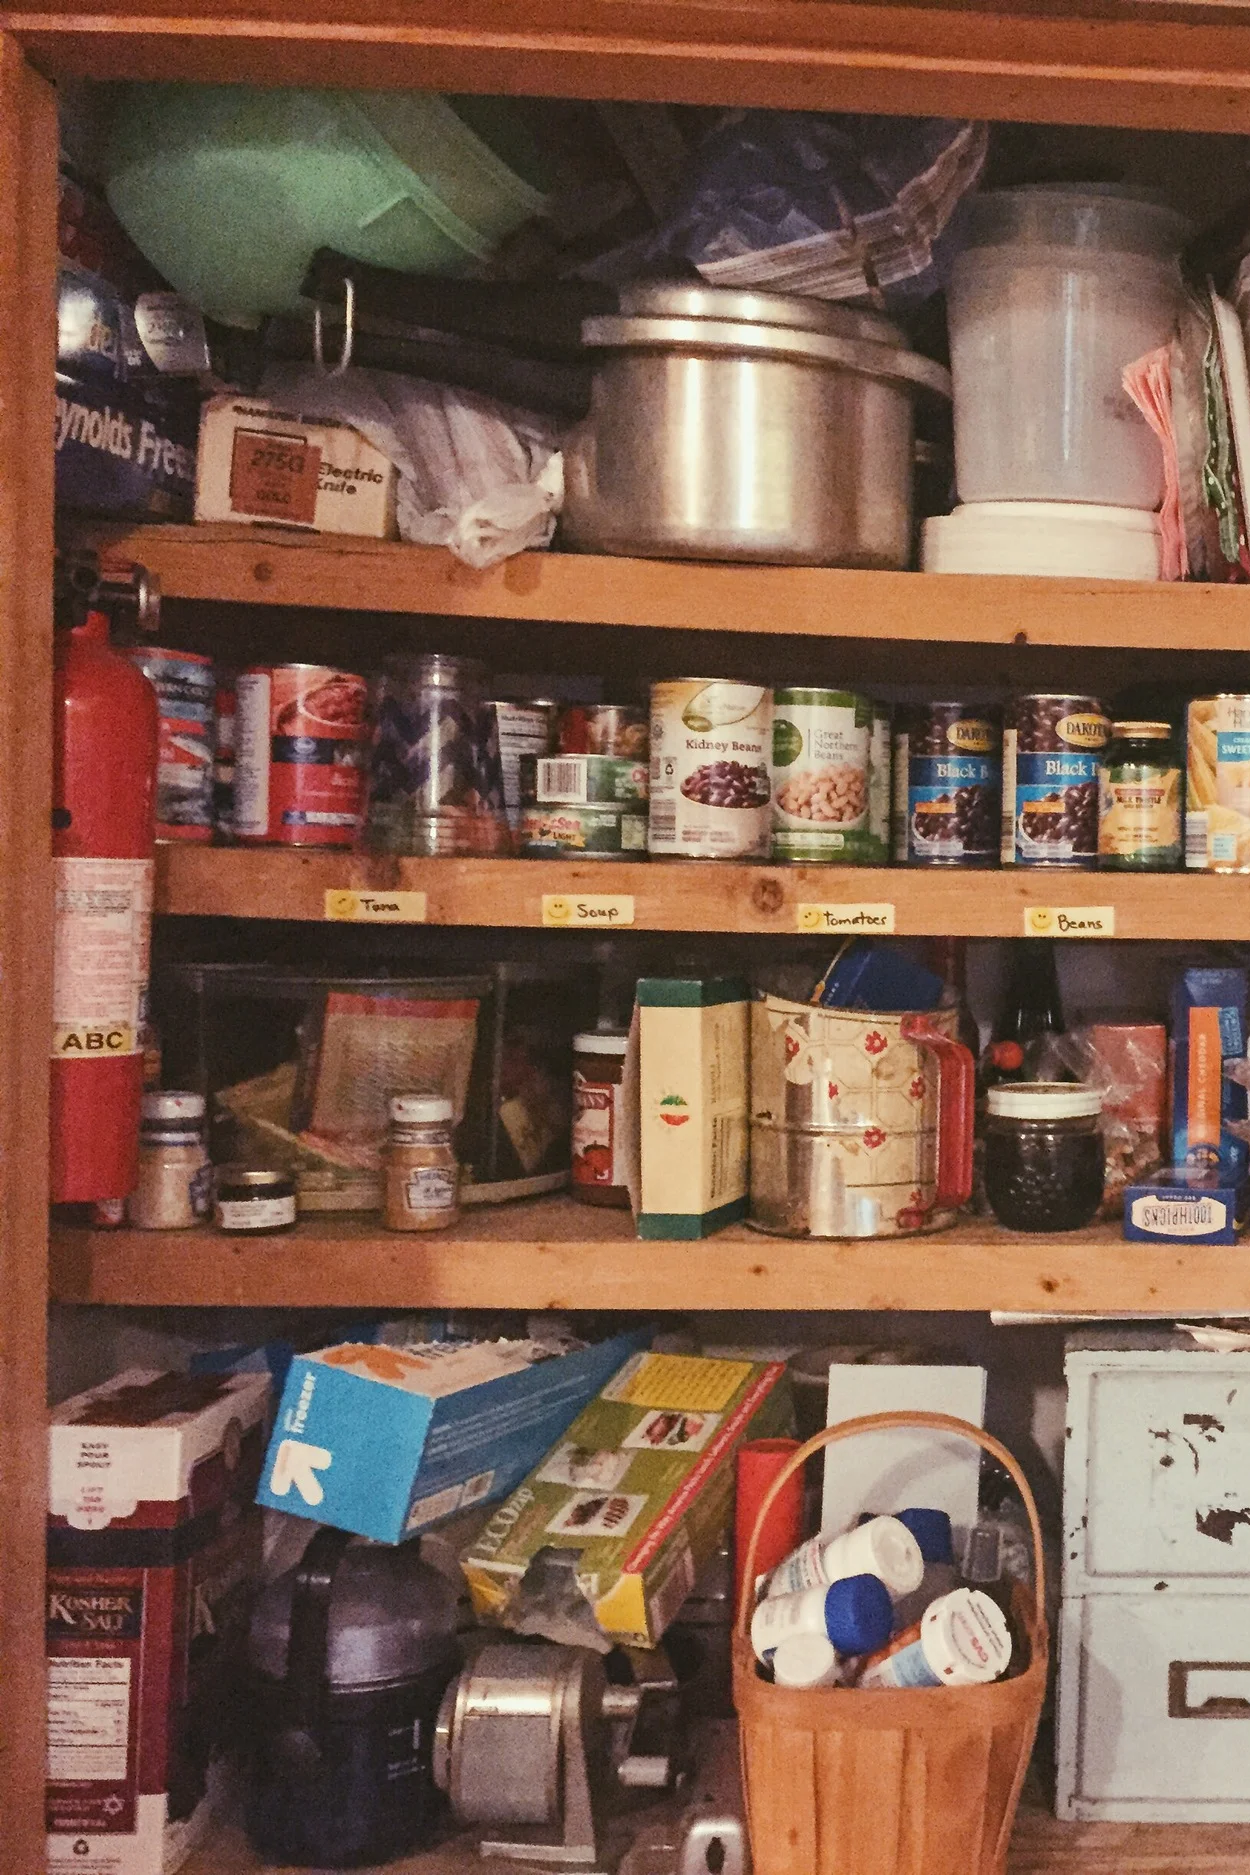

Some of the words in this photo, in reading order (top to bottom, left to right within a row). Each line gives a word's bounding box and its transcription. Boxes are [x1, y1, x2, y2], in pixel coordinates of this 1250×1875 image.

[814, 729, 844, 740] Great
[686, 739, 729, 752] Kidney
[732, 741, 762, 754] Beans
[814, 740, 858, 751] Northern
[814, 750, 844, 761] Beans
[937, 763, 976, 778] Black
[1045, 760, 1087, 776] Black
[577, 903, 619, 921] Soup
[1057, 914, 1103, 931] Beans
[61, 1031, 124, 1050] ABC
[1143, 1203, 1214, 1226] TOOTHPICKS
[284, 1371, 316, 1433] freezer
